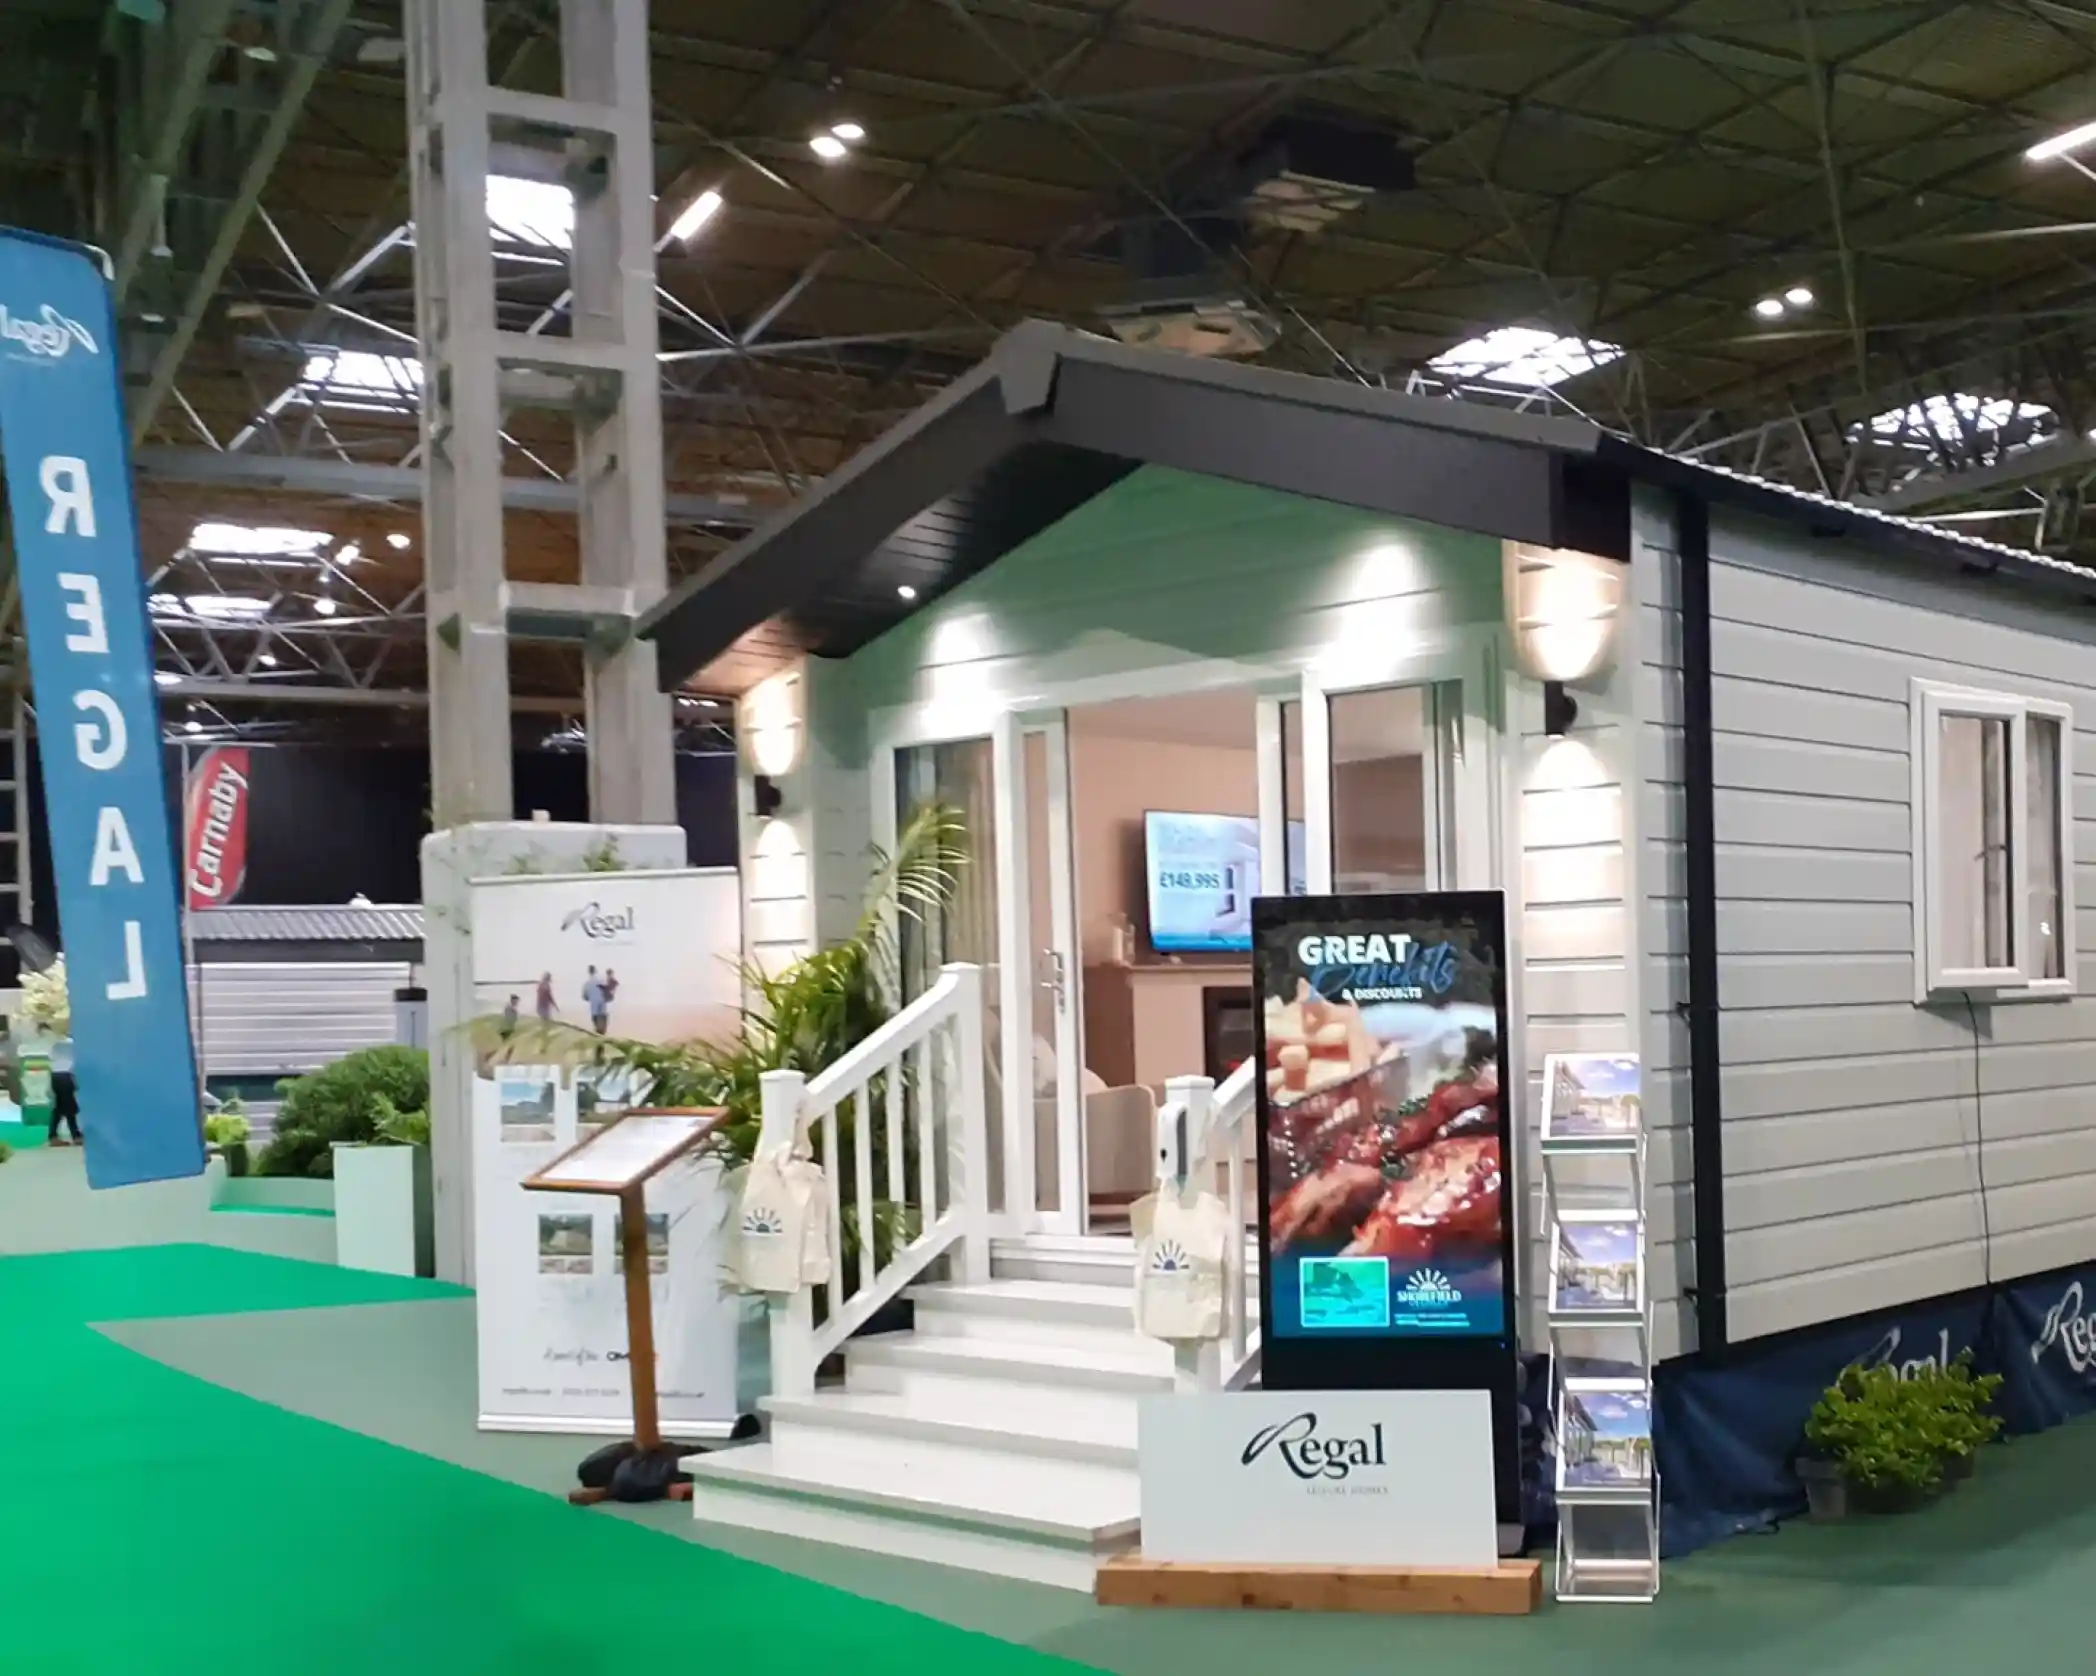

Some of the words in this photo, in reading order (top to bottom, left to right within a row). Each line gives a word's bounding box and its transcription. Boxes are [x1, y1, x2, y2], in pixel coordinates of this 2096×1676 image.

[188, 761, 249, 896] Carnaby
[560, 901, 634, 938] Regal
[1298, 933, 1411, 965] GREAT
[1354, 987, 1422, 1000] DISCOUNTS
[1241, 1412, 1387, 1480] Regal
